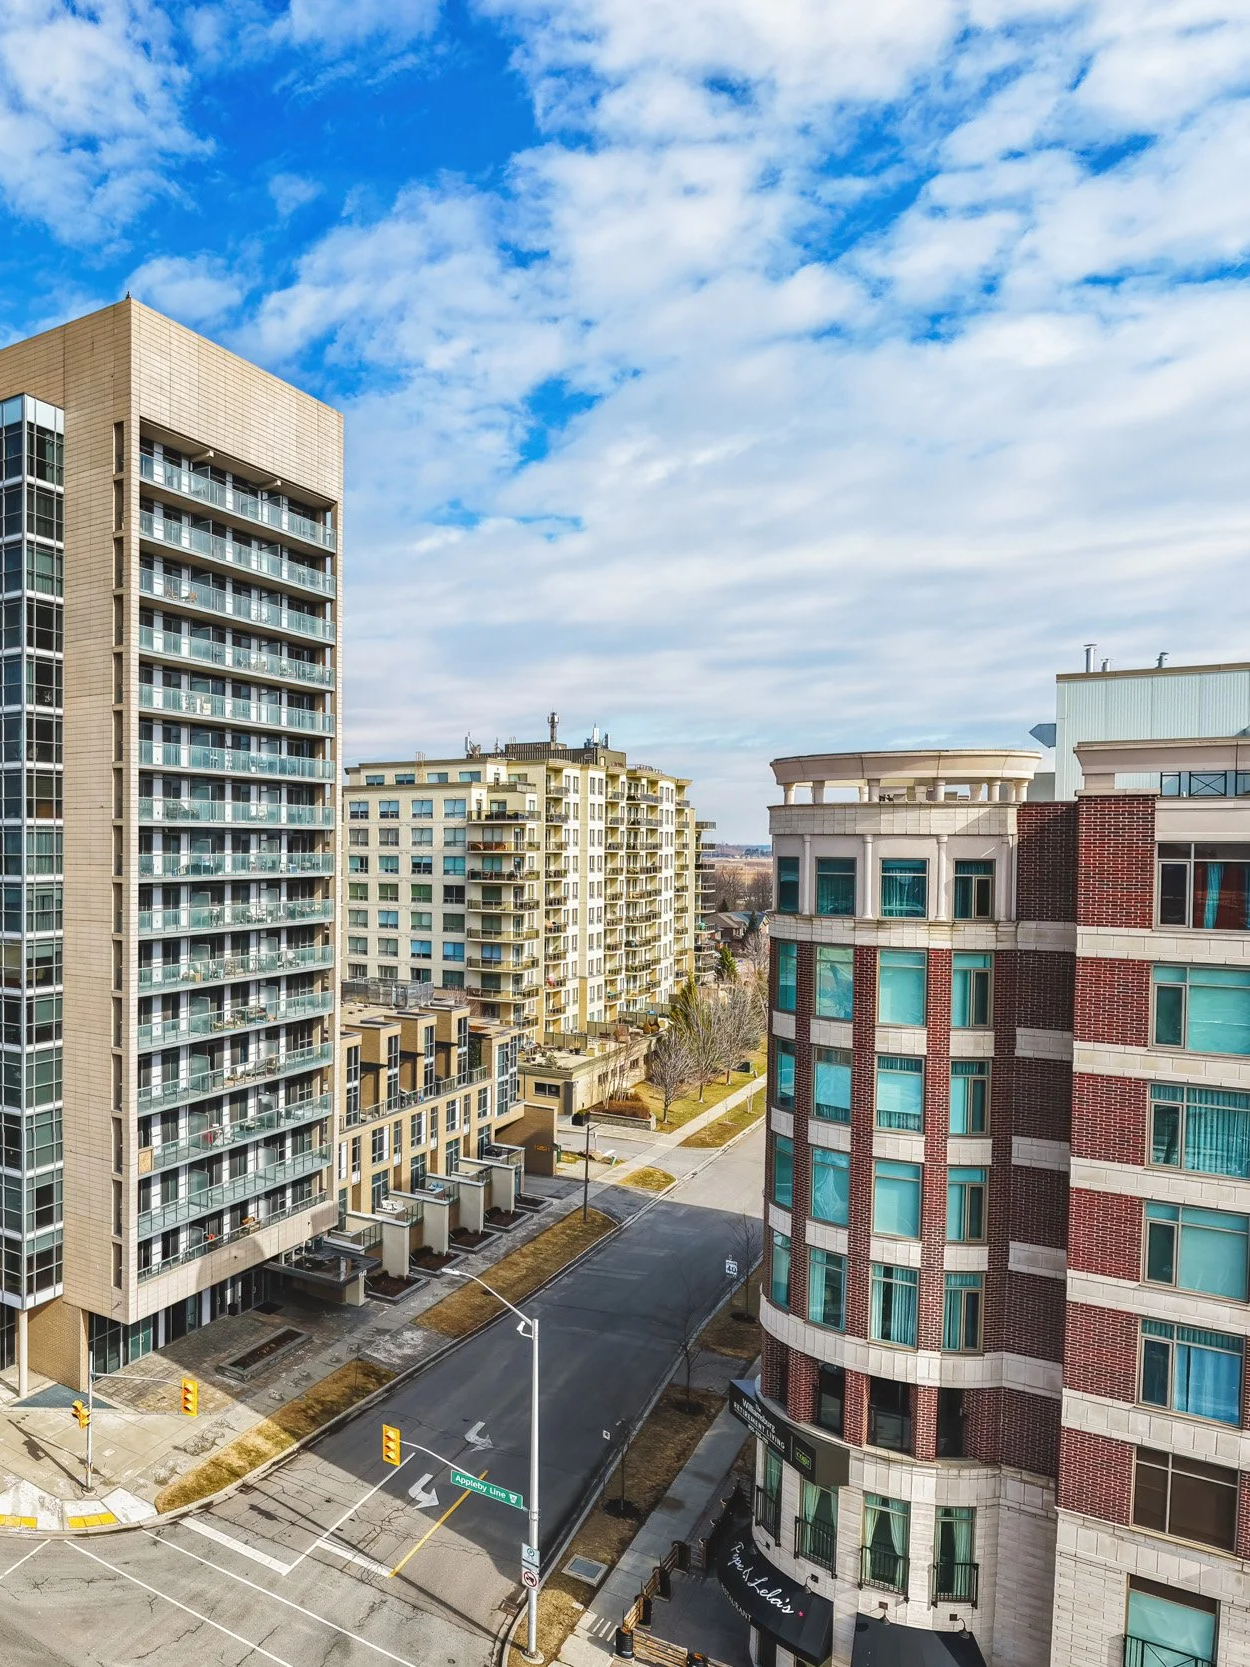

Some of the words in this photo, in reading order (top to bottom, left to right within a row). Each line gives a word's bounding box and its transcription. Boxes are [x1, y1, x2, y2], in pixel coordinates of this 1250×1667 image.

[733, 1401, 765, 1433] RETIREMENT
[766, 1430, 786, 1450] LIVING
[742, 1398, 776, 1434] Williamsburg
[455, 1475, 488, 1492] Appleby
[489, 1487, 507, 1499] Line
[747, 1577, 795, 1614] Lela's
